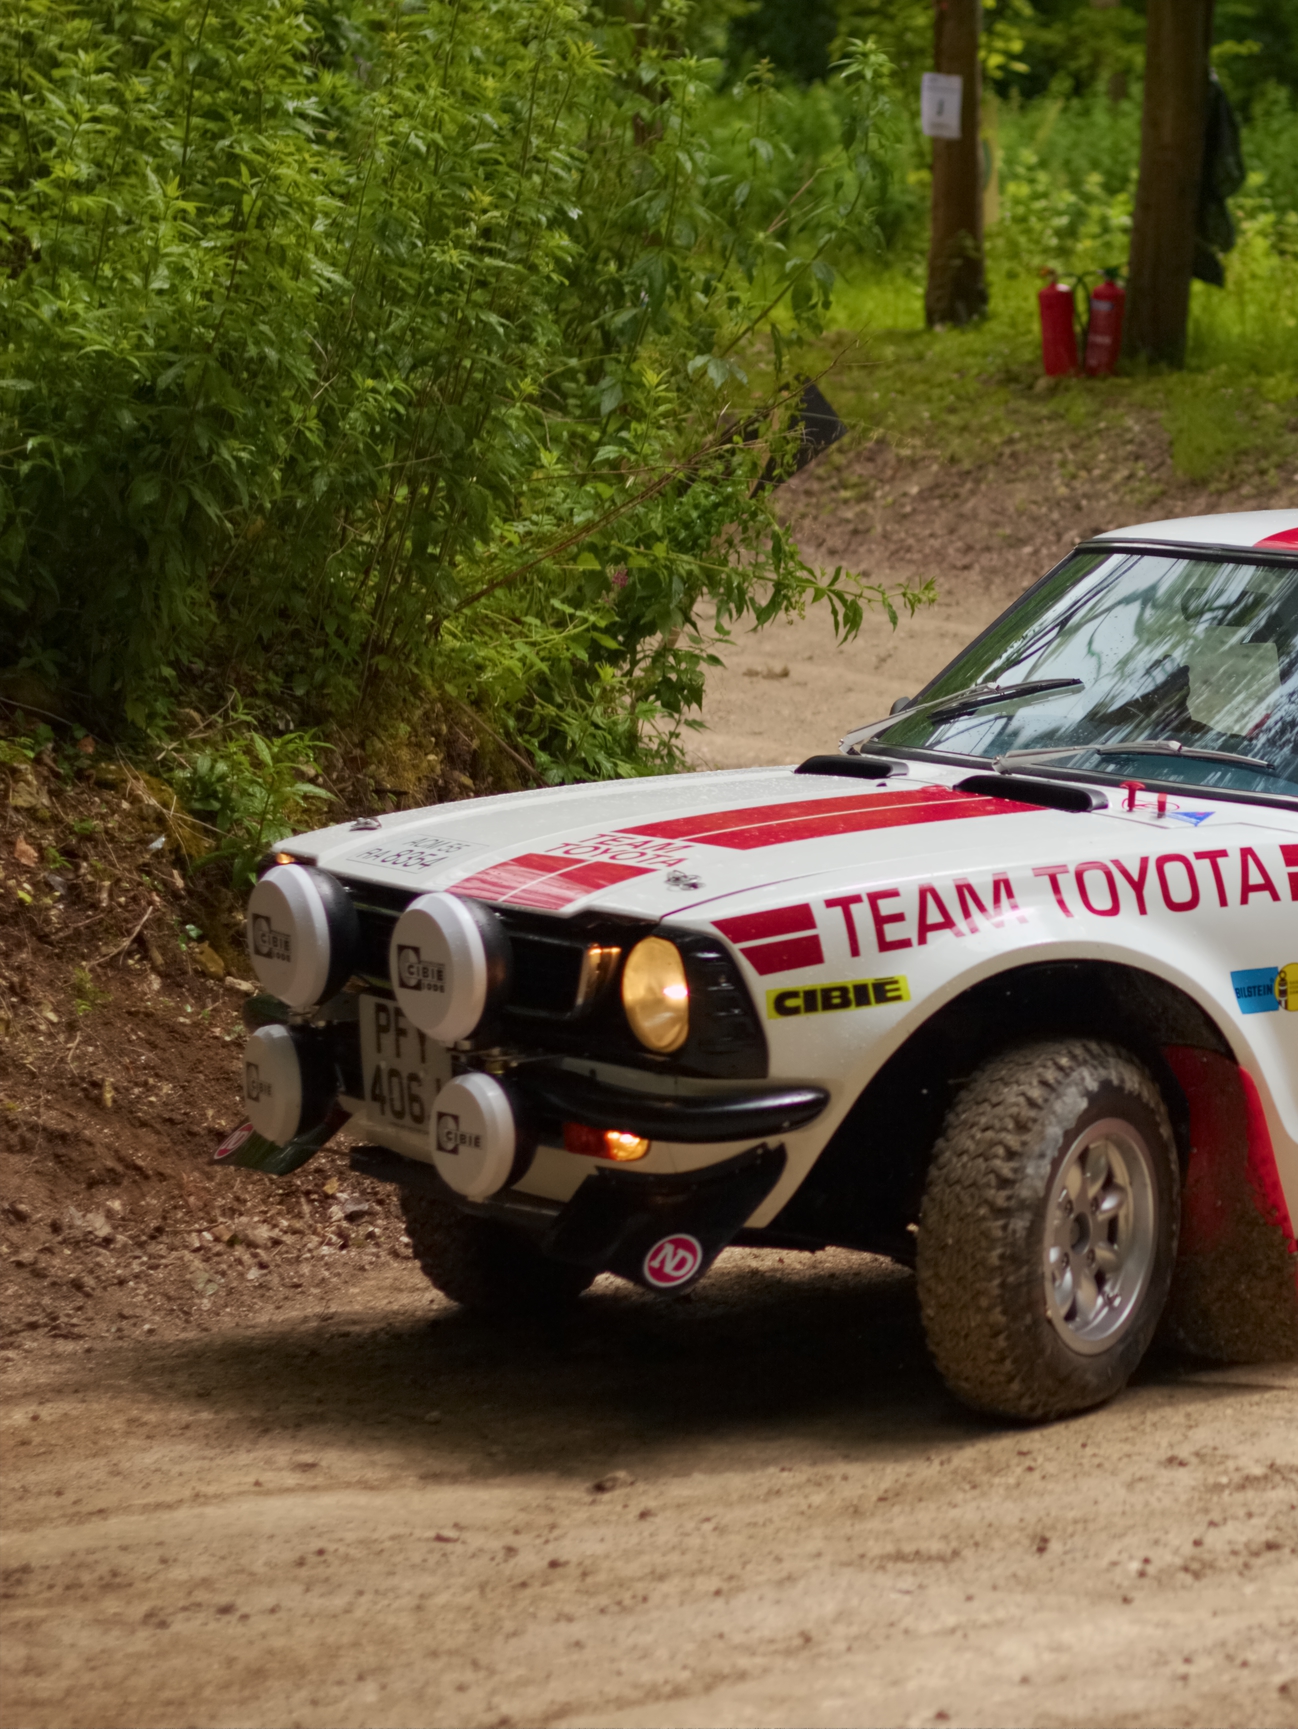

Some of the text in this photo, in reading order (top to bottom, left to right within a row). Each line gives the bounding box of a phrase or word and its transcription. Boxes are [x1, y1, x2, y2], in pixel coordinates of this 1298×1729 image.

[544, 842, 688, 867] TOYOTA
[578, 834, 695, 853] TEAM
[356, 848, 449, 870] RA 8354
[824, 847, 1281, 957] TEAM TOYOTA
[1235, 984, 1273, 999] BILSTEIN
[370, 1064, 426, 1125] 406
[650, 1242, 694, 1277] ND
